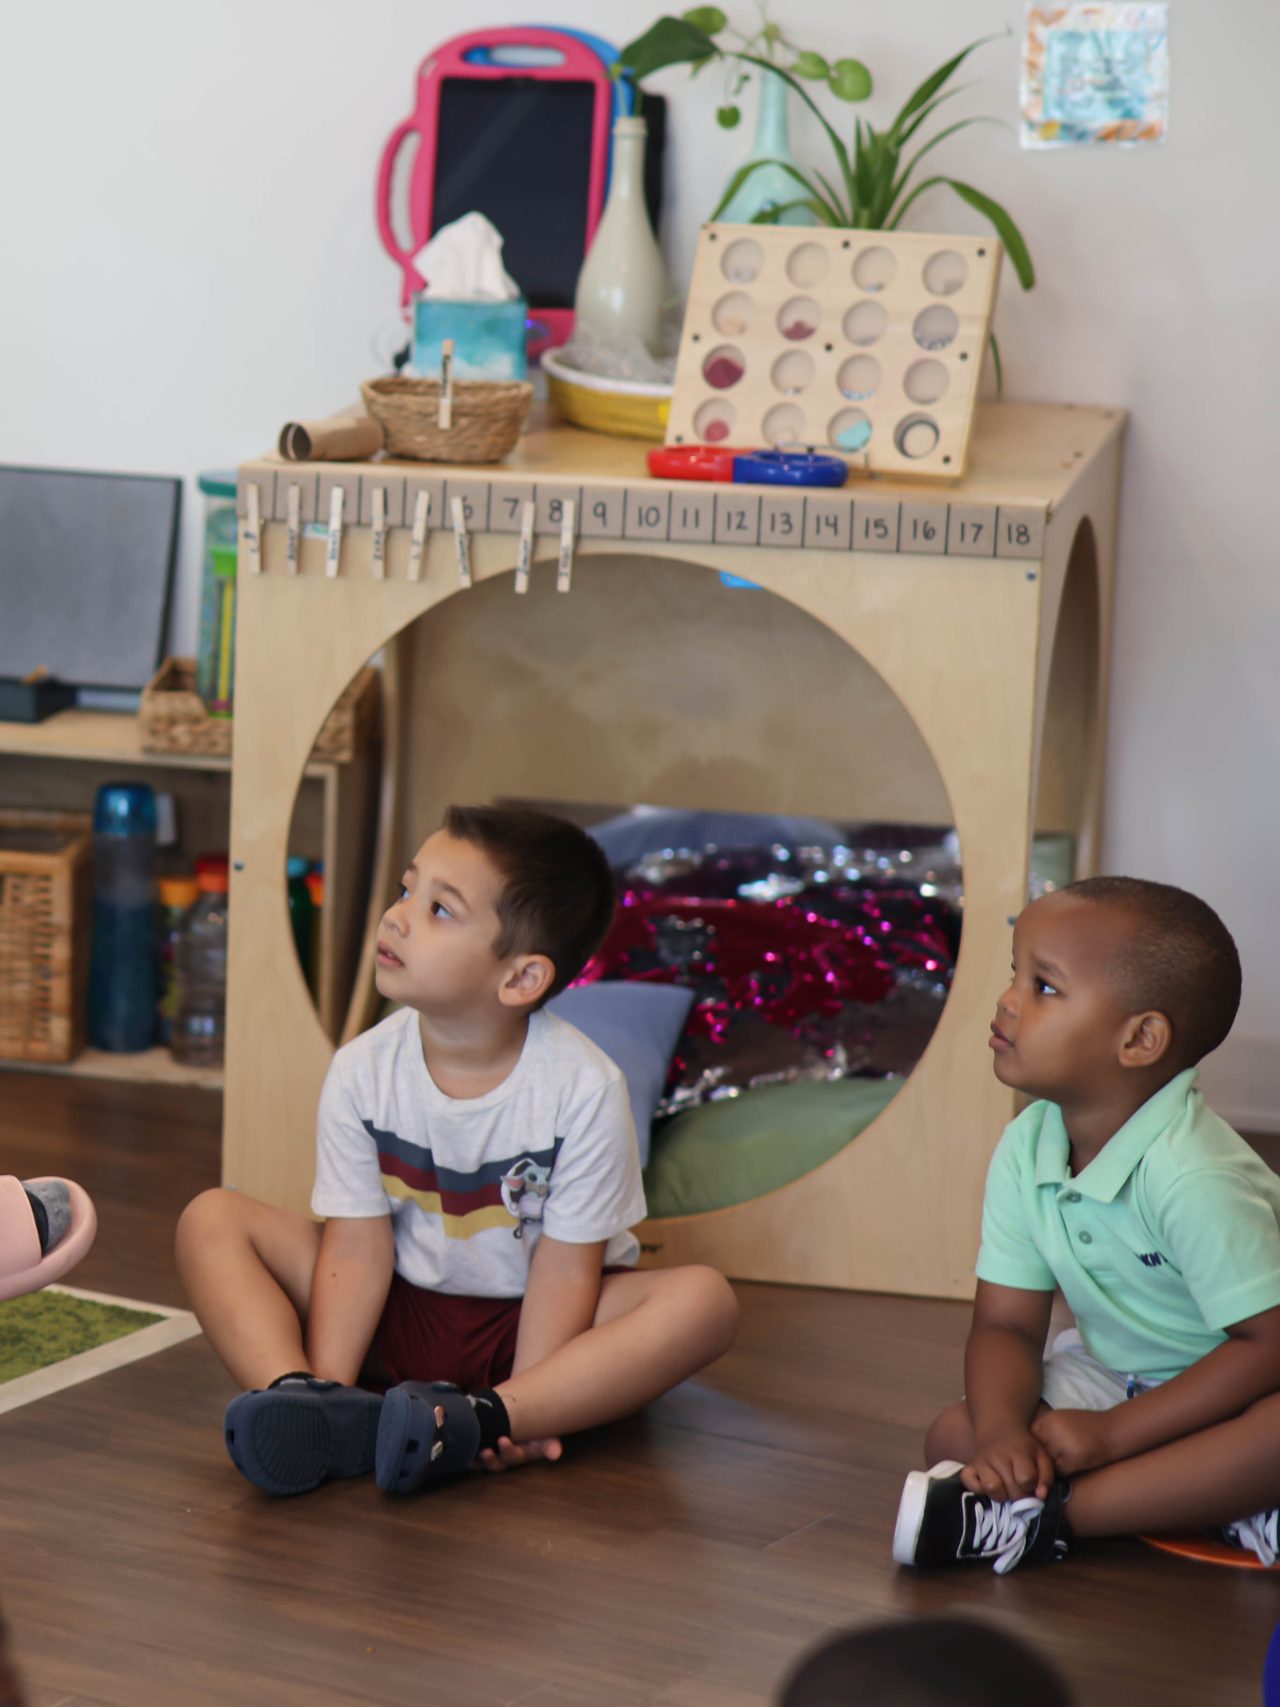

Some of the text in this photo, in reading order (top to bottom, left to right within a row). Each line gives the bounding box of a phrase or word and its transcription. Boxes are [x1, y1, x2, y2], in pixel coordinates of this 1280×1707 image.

[502, 496, 519, 520] 7
[548, 498, 564, 524] 8
[592, 501, 608, 528] 9
[637, 505, 661, 528] 10
[681, 508, 701, 529] 11
[726, 511, 748, 531] 12
[770, 512, 794, 534] 13
[815, 515, 839, 537] 14
[863, 517, 889, 539] 15
[912, 518, 936, 541] 16
[960, 521, 983, 543] 17
[1006, 523, 1031, 545] 18
